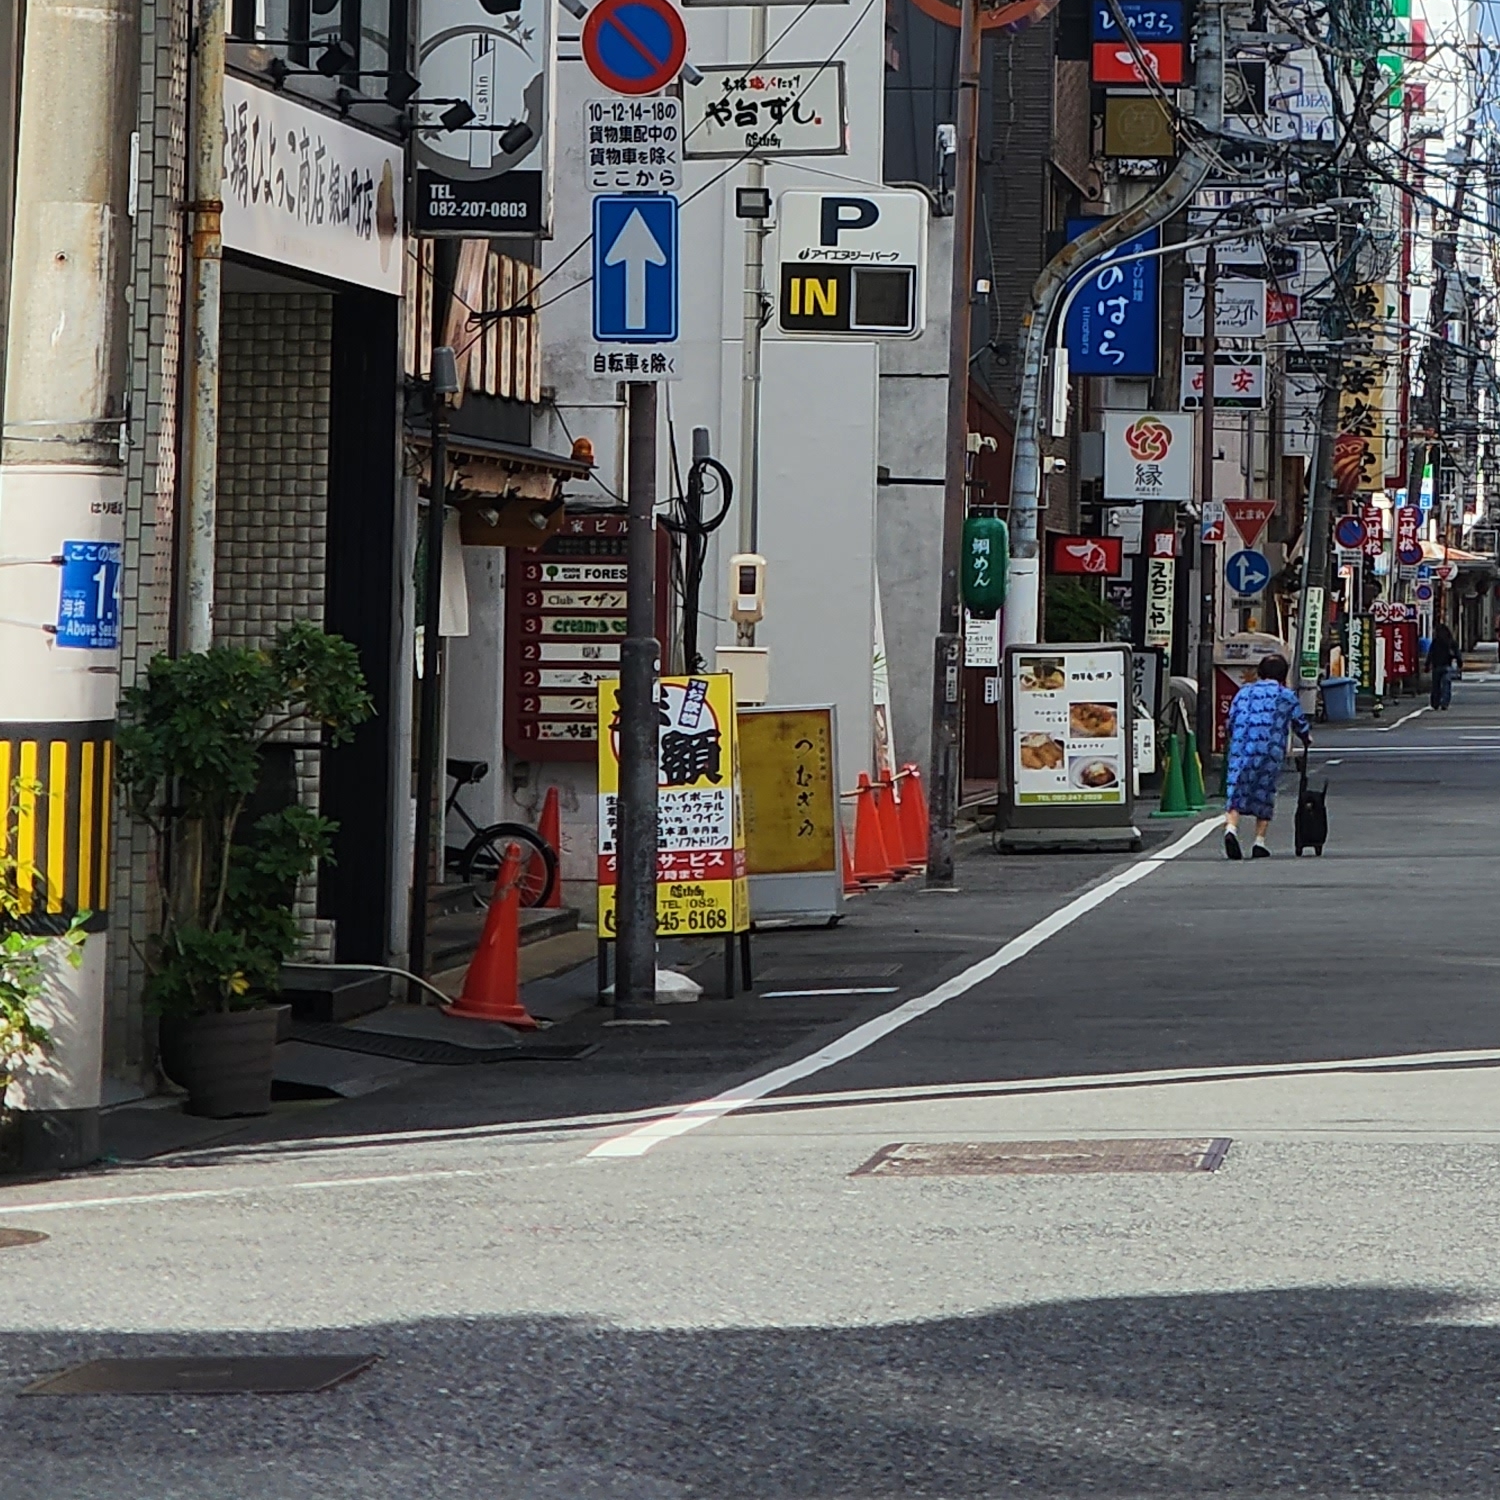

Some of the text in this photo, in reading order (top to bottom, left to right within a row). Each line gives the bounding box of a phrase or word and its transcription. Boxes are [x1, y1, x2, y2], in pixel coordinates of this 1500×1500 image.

[588, 126, 678, 144] 貨物集配中の
[588, 148, 677, 167] 貨物車を除く
[592, 169, 676, 188] ここから
[429, 201, 528, 217] 082-207-0803
[820, 197, 880, 247] P
[789, 277, 838, 317] IN
[592, 352, 677, 375] 自転車を除く
[1135, 463, 1163, 488] 縁
[1234, 507, 1268, 521] 止まれ
[526, 565, 537, 580] 3
[525, 592, 622, 608] 3 Club マザン
[66, 619, 97, 637] Above
[524, 618, 535, 633] 3
[523, 645, 535, 659] 2
[523, 671, 535, 685] 2
[523, 697, 535, 712] 2
[523, 725, 531, 738] 1
[661, 901, 682, 911] TEL
